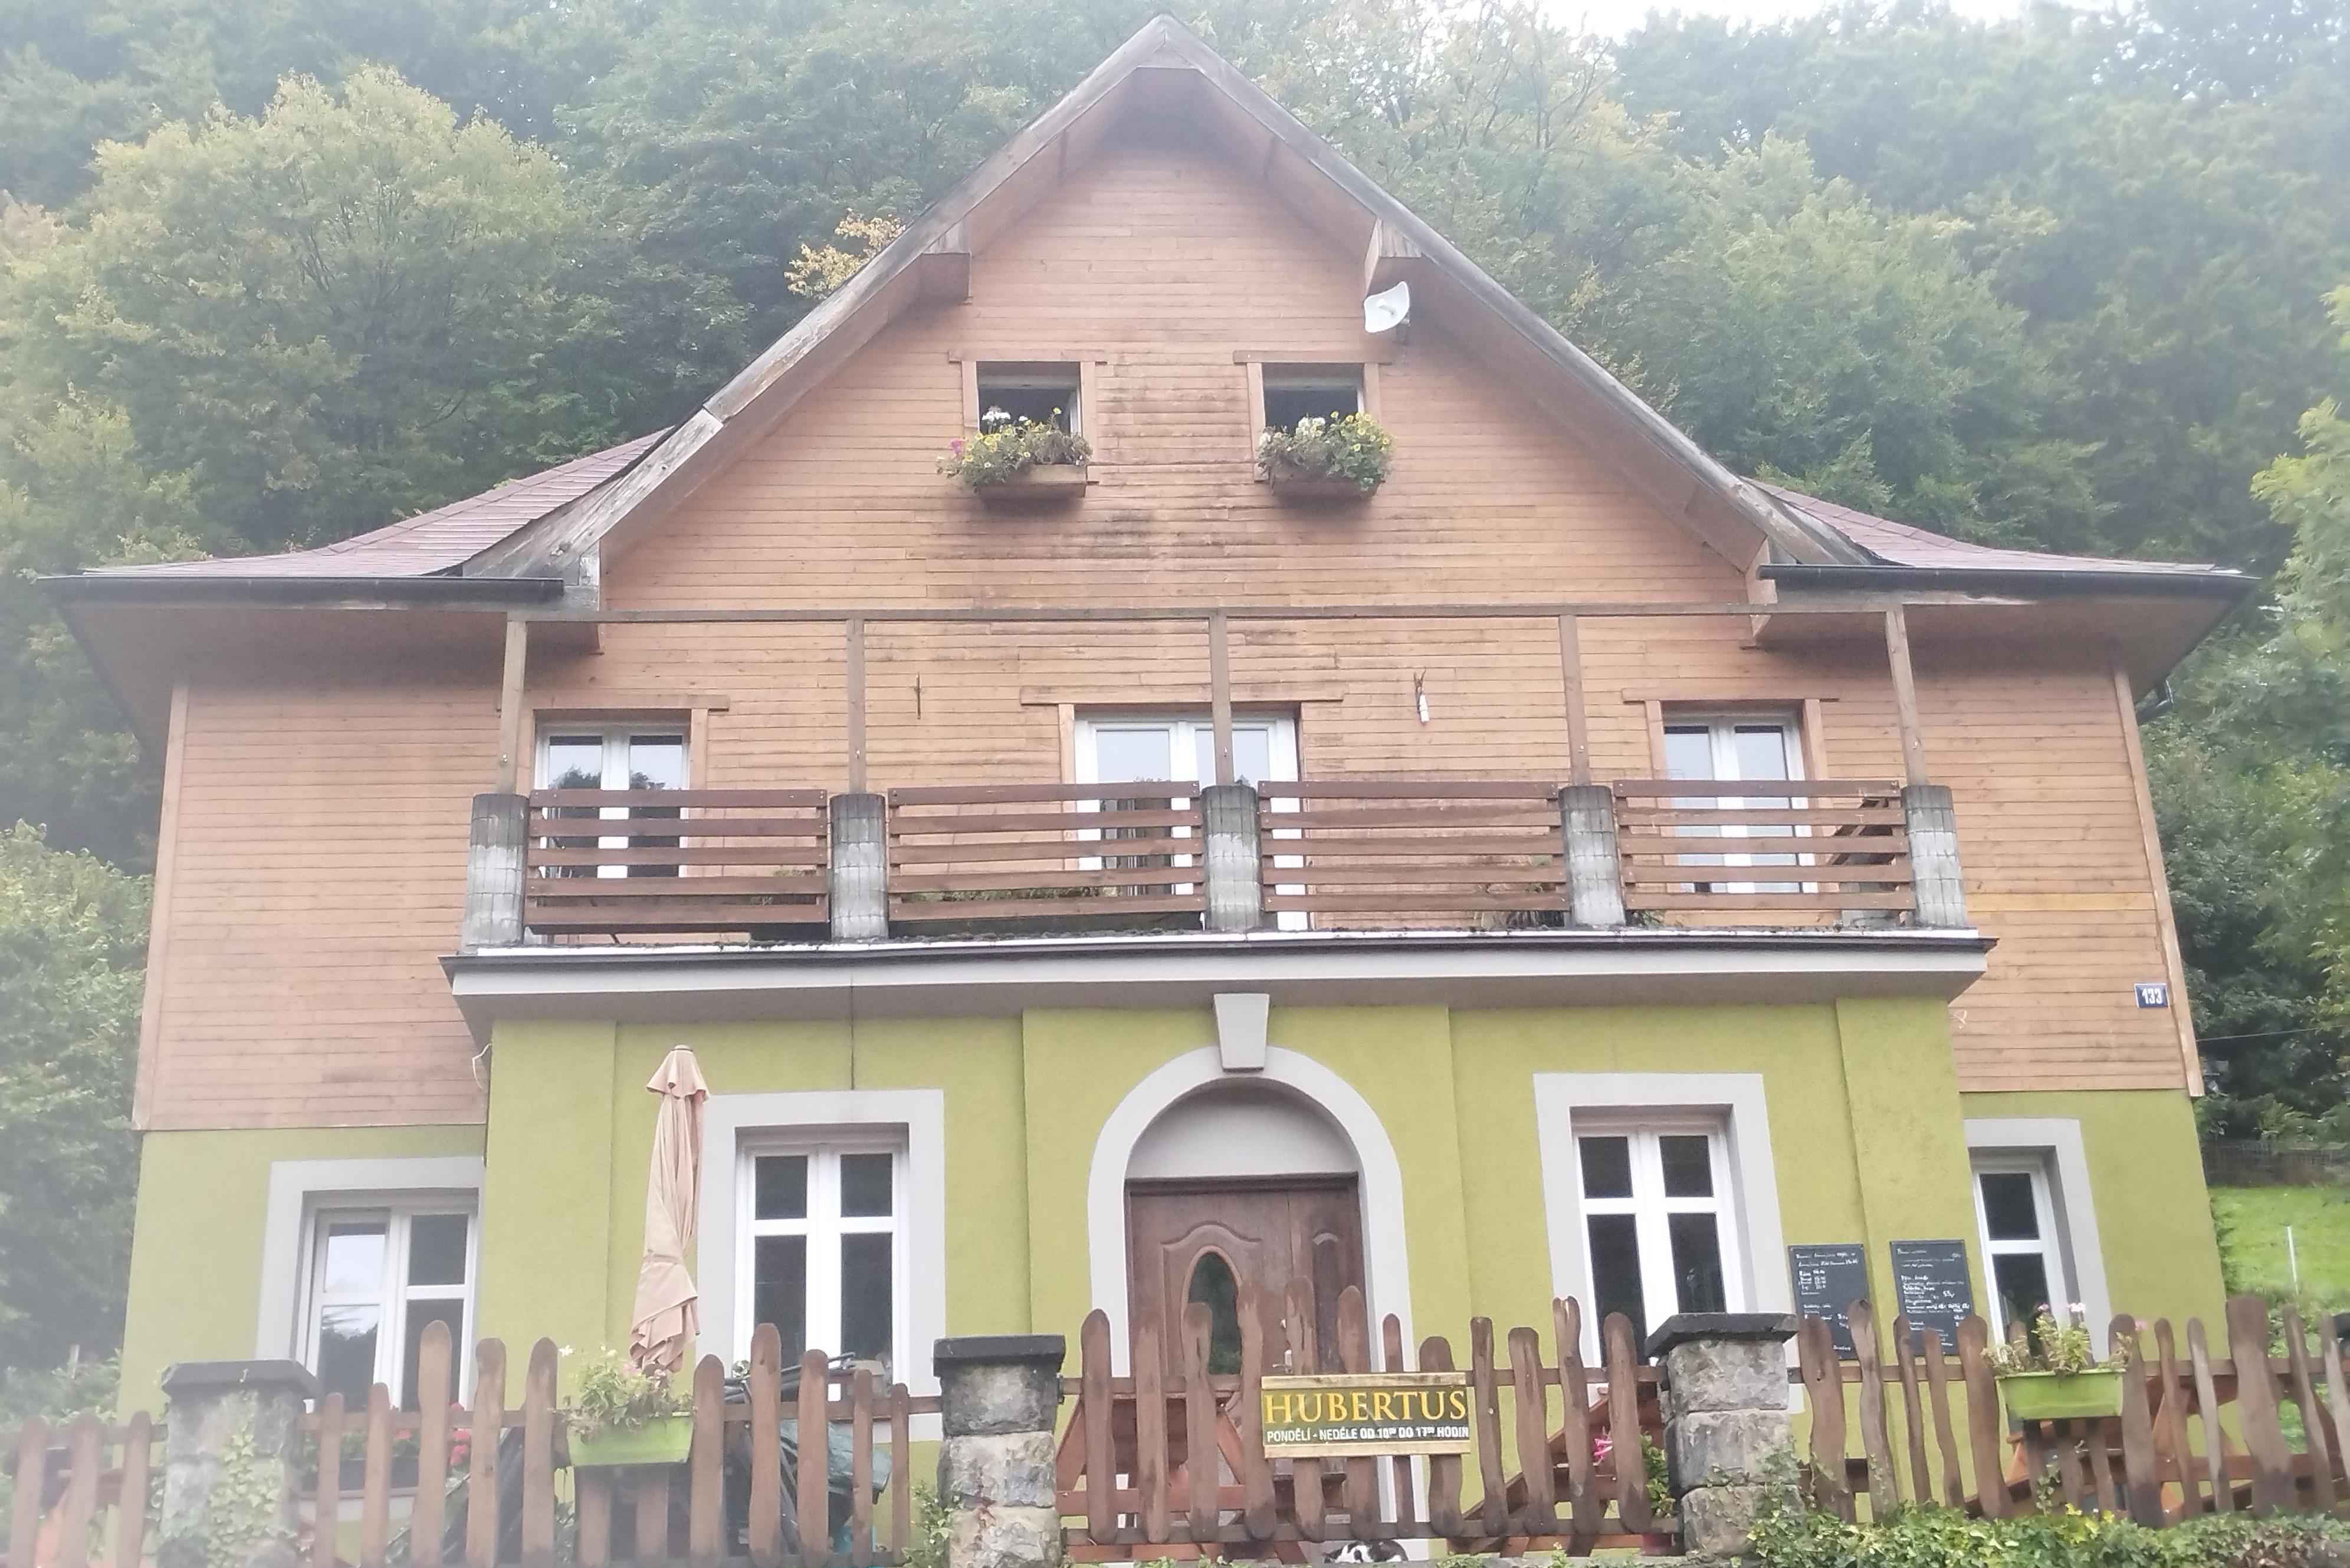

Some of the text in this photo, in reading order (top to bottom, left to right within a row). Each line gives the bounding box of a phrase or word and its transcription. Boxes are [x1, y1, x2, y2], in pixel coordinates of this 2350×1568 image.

[2142, 988, 2162, 1004] 133
[1264, 1391, 1466, 1424] HUBERTUS
[1359, 1427, 1375, 1439] OD
[1398, 1426, 1414, 1438] DO
[1437, 1425, 1469, 1438] HODIN
